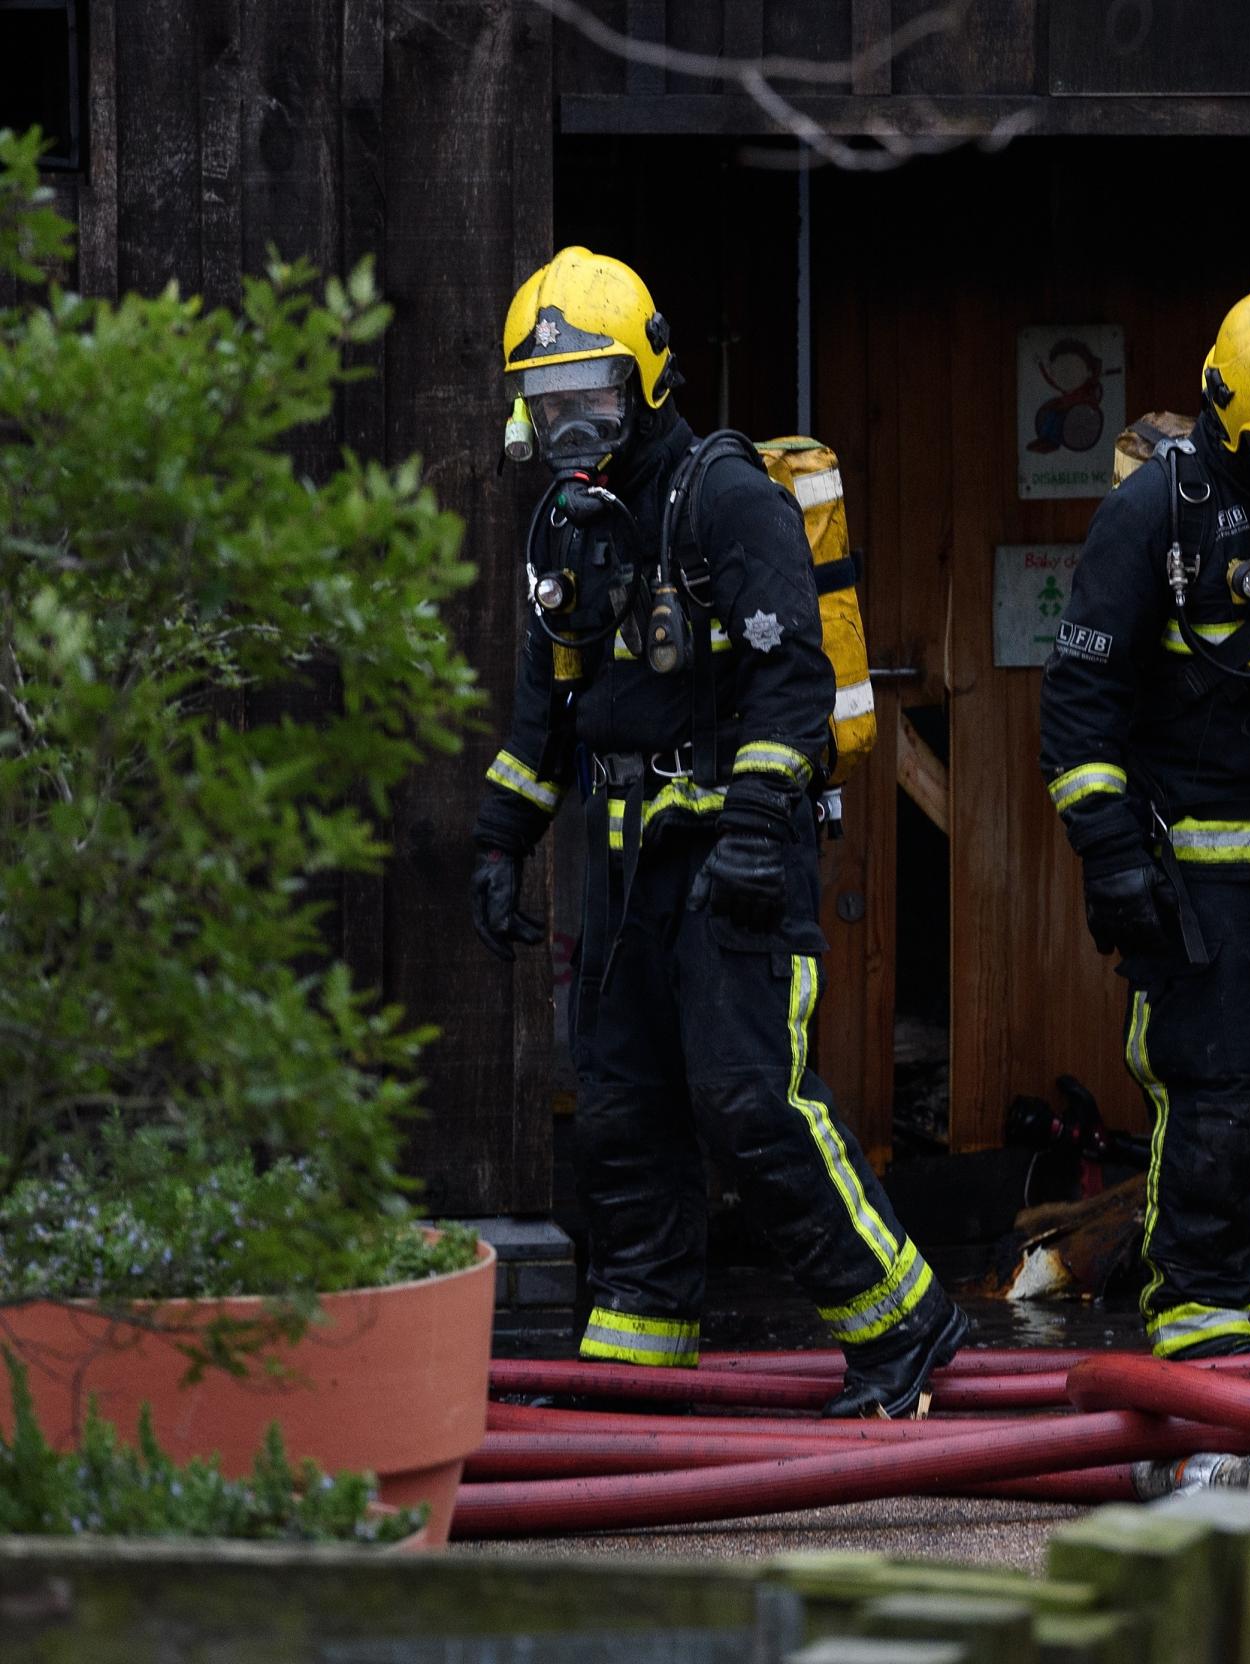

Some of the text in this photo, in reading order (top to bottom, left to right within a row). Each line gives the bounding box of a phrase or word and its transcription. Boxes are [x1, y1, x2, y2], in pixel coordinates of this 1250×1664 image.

[1032, 471, 1088, 485] DISABLED
[1025, 552, 1059, 570] Baby
[1058, 621, 1108, 653] LFB
